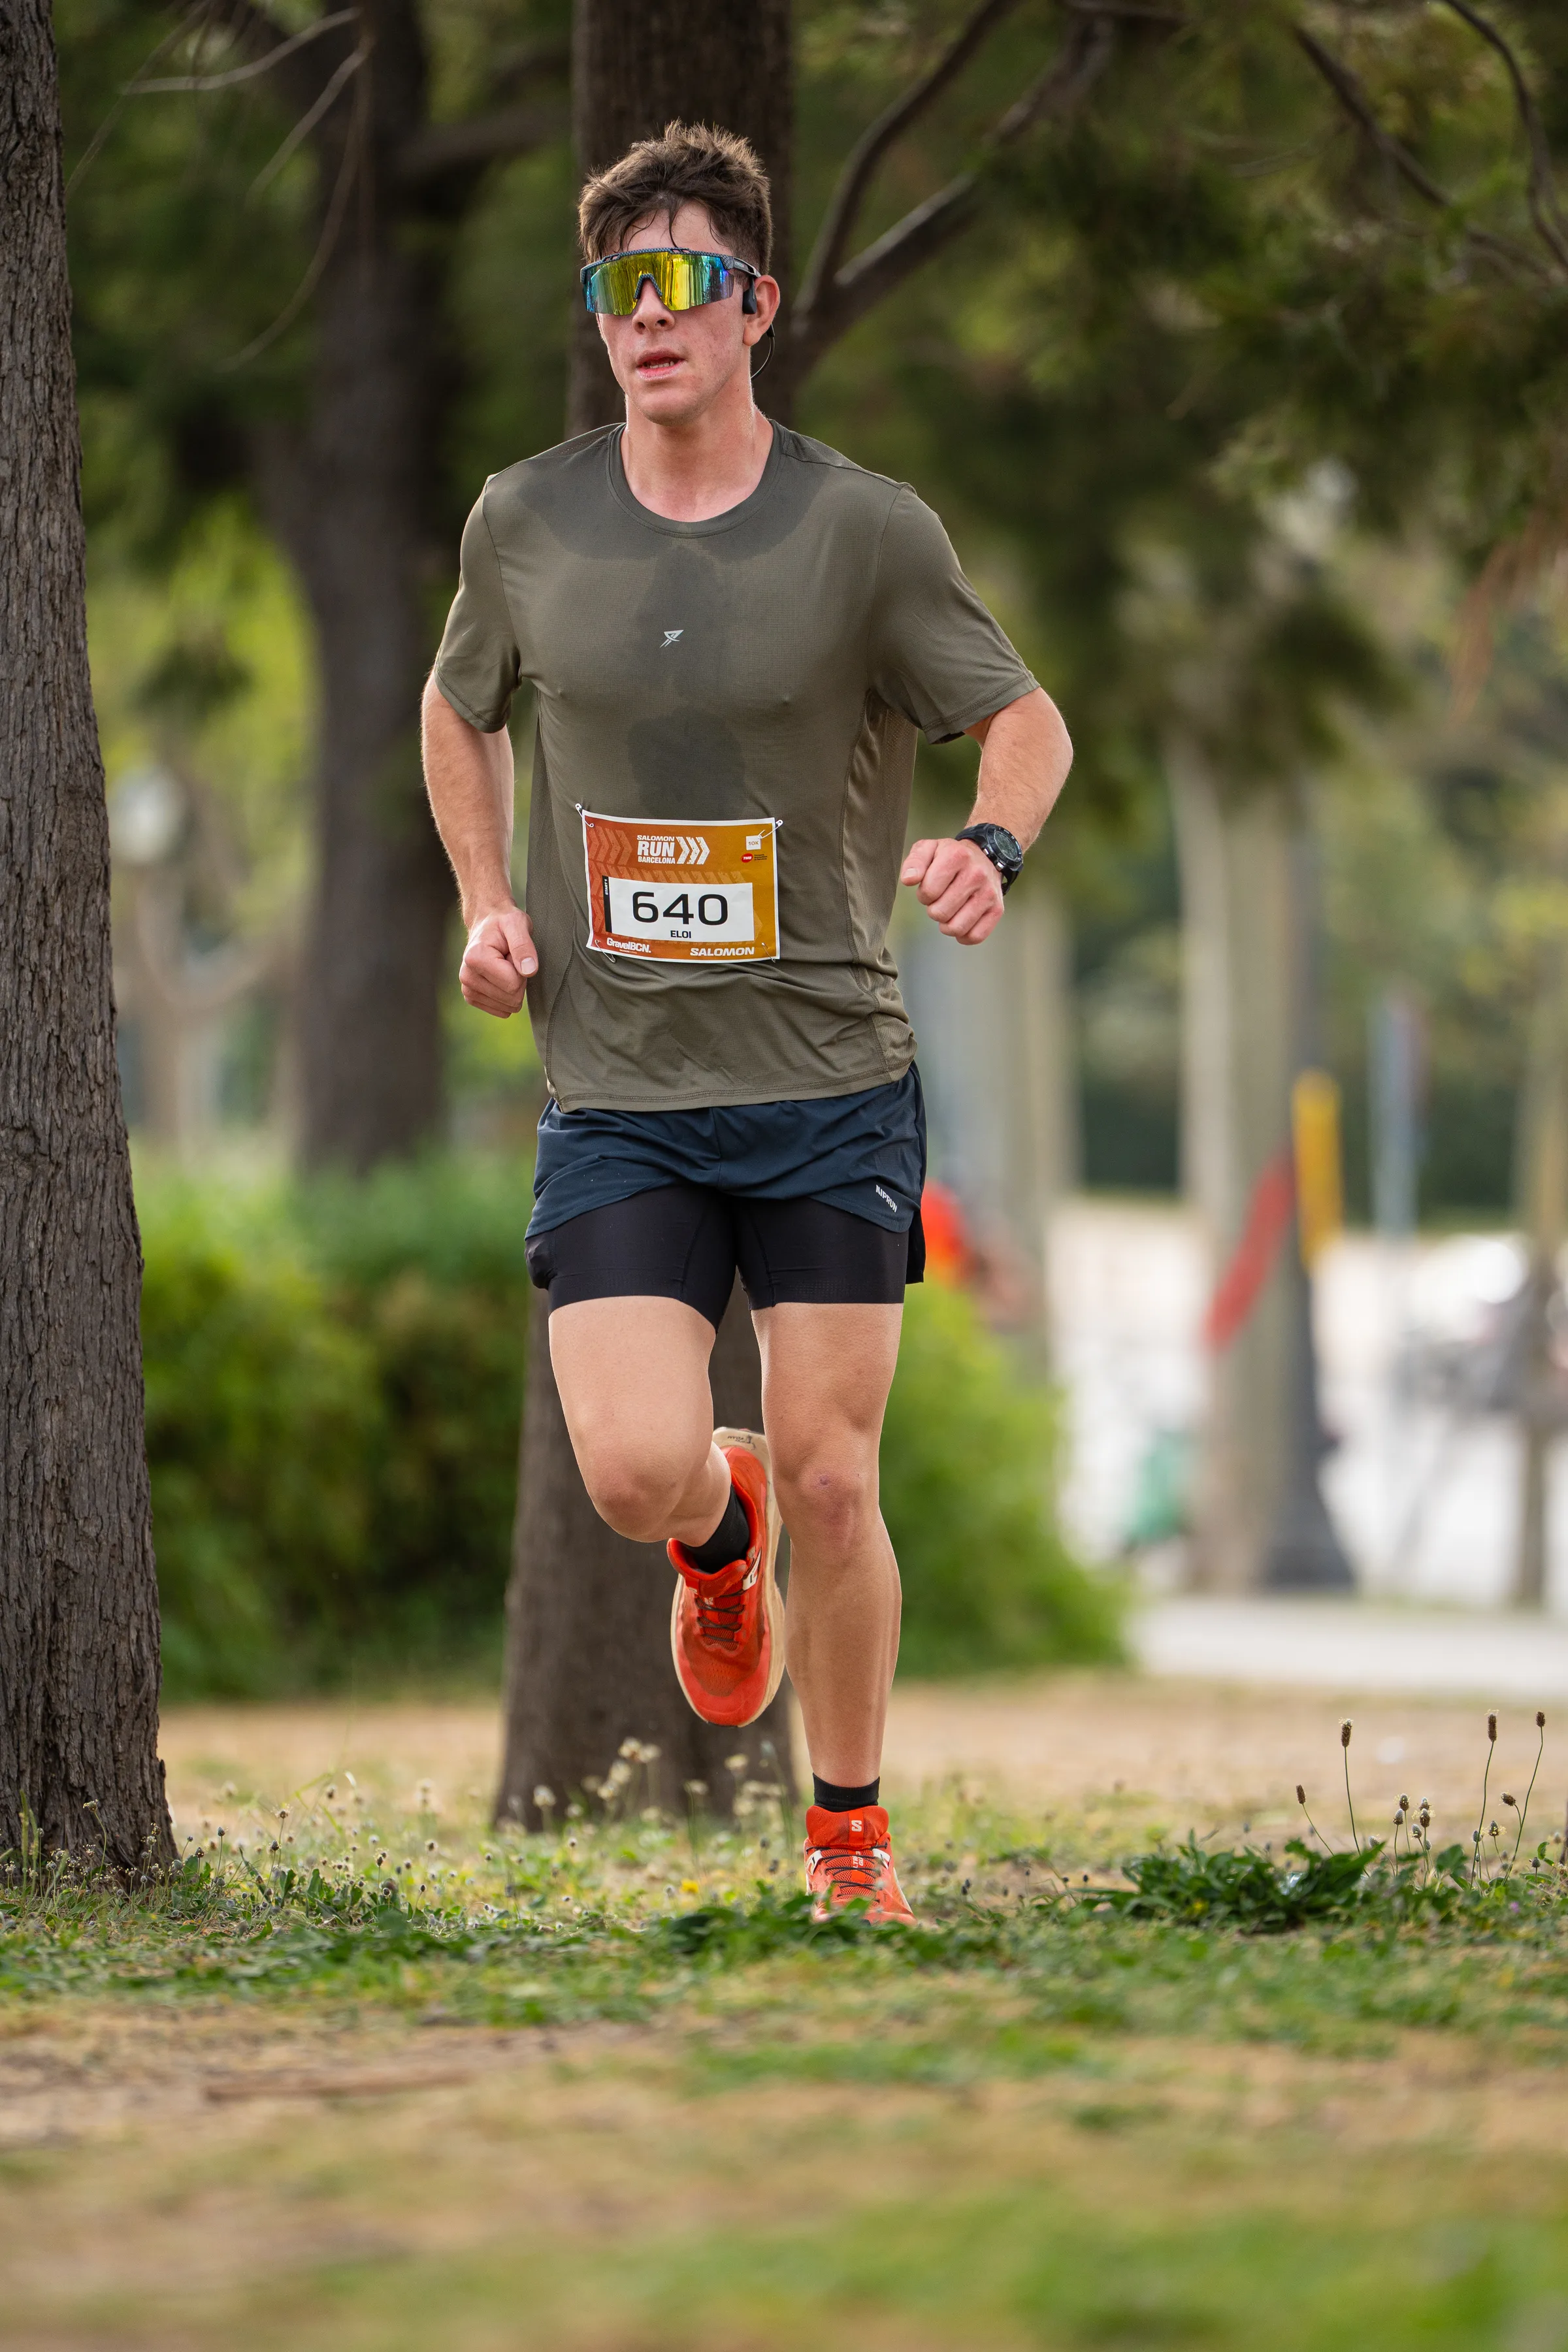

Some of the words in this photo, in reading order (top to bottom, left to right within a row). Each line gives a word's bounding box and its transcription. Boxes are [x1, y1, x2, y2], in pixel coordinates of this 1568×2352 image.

[637, 841, 675, 857] RUN
[638, 856, 676, 864] BARCELONA
[632, 891, 728, 926] 640
[670, 930, 692, 939] ELOI
[690, 947, 755, 956] SALOMON
[875, 1184, 898, 1213] KIPRUN
